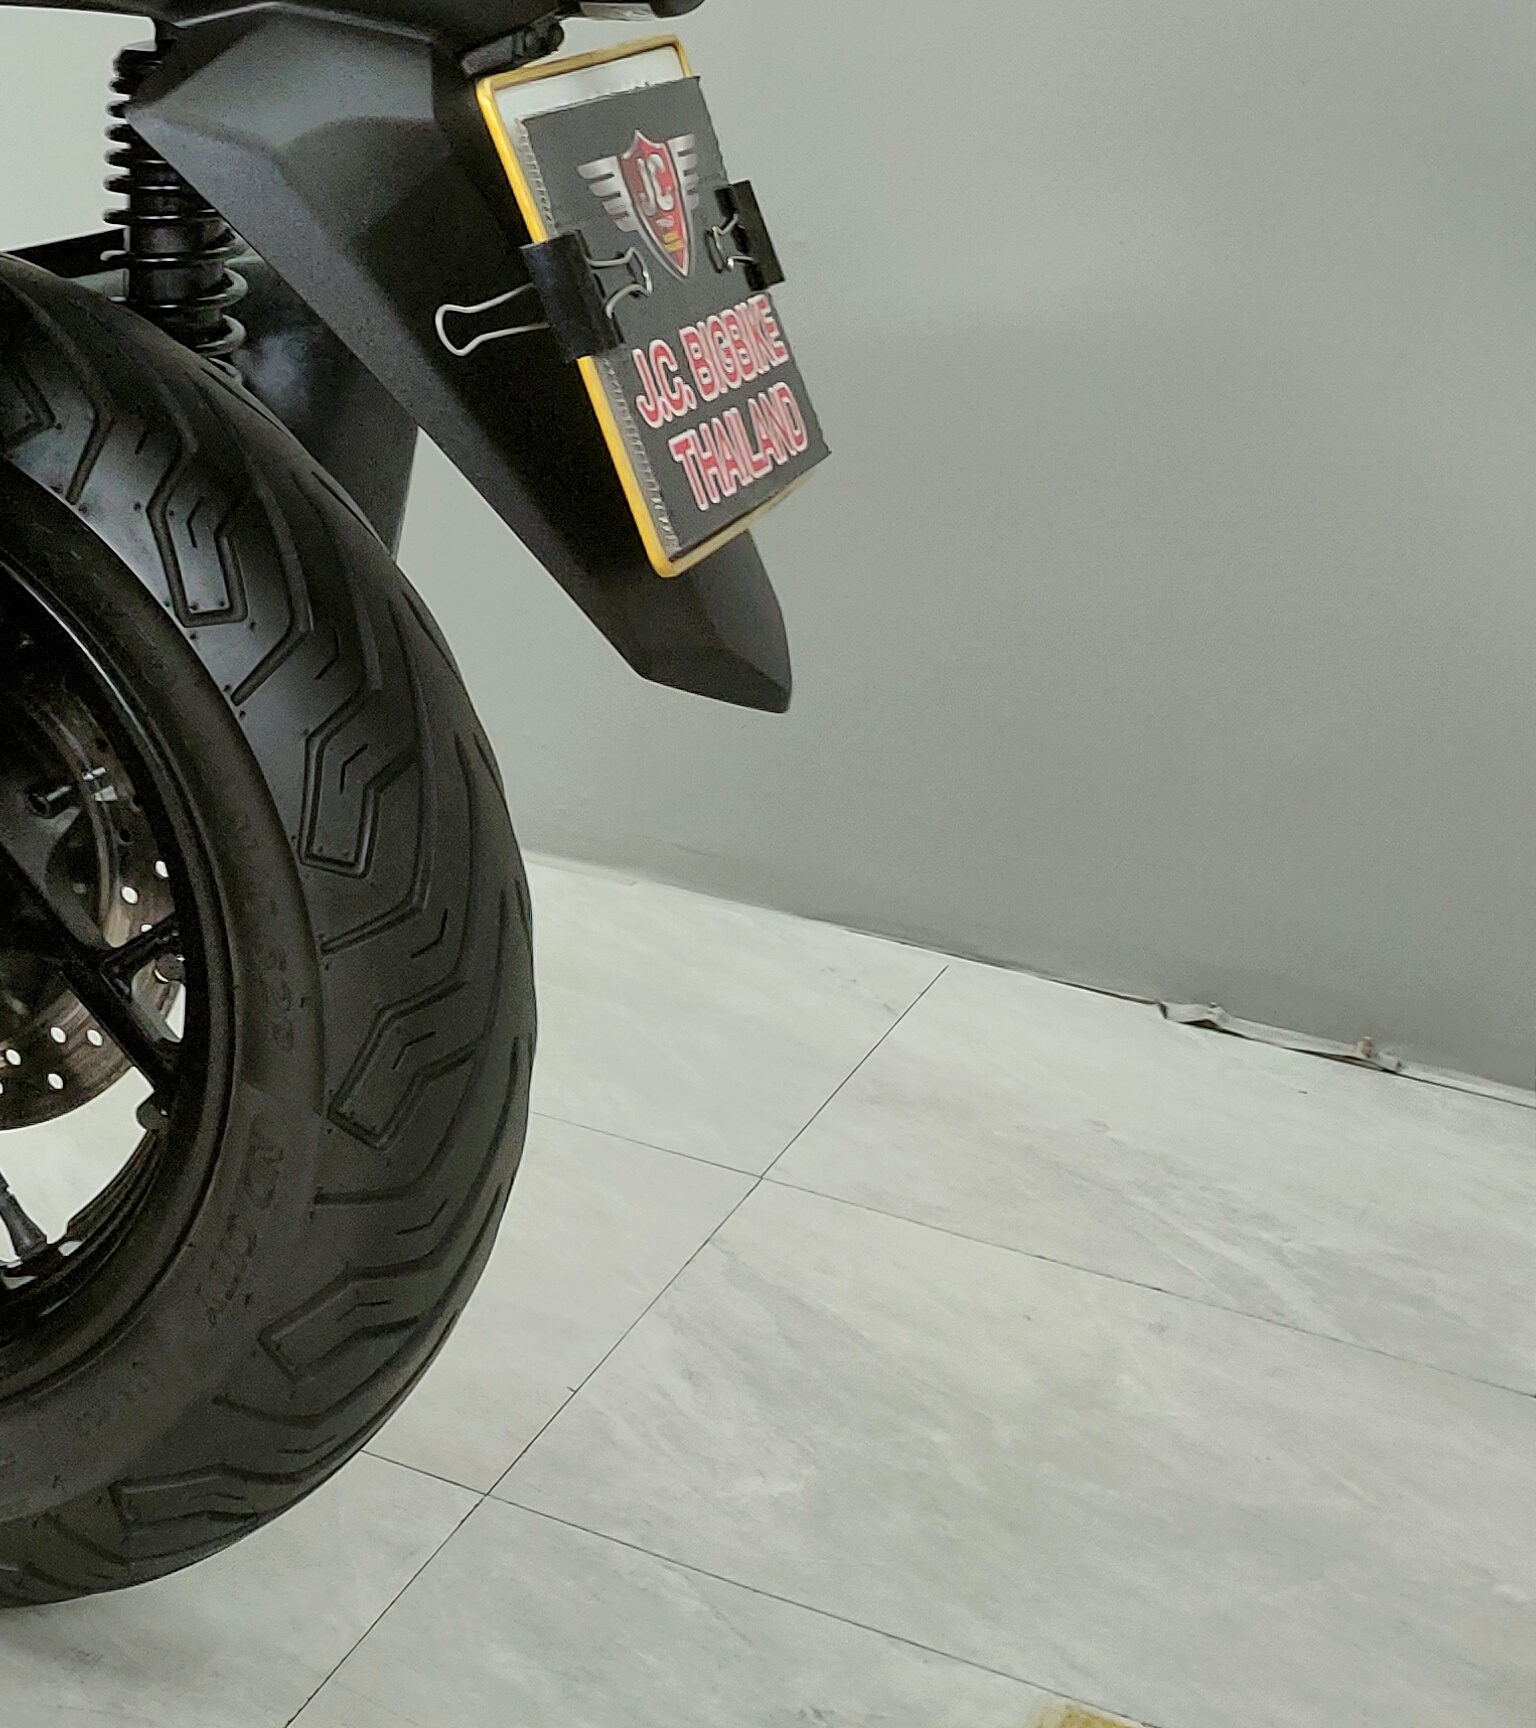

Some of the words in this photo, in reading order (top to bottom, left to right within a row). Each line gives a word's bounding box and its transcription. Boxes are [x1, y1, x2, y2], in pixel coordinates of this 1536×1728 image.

[634, 153, 675, 217] JC
[632, 339, 697, 428] J.C.
[679, 294, 789, 402] BIGBIKE
[668, 382, 808, 511] THAILAND
